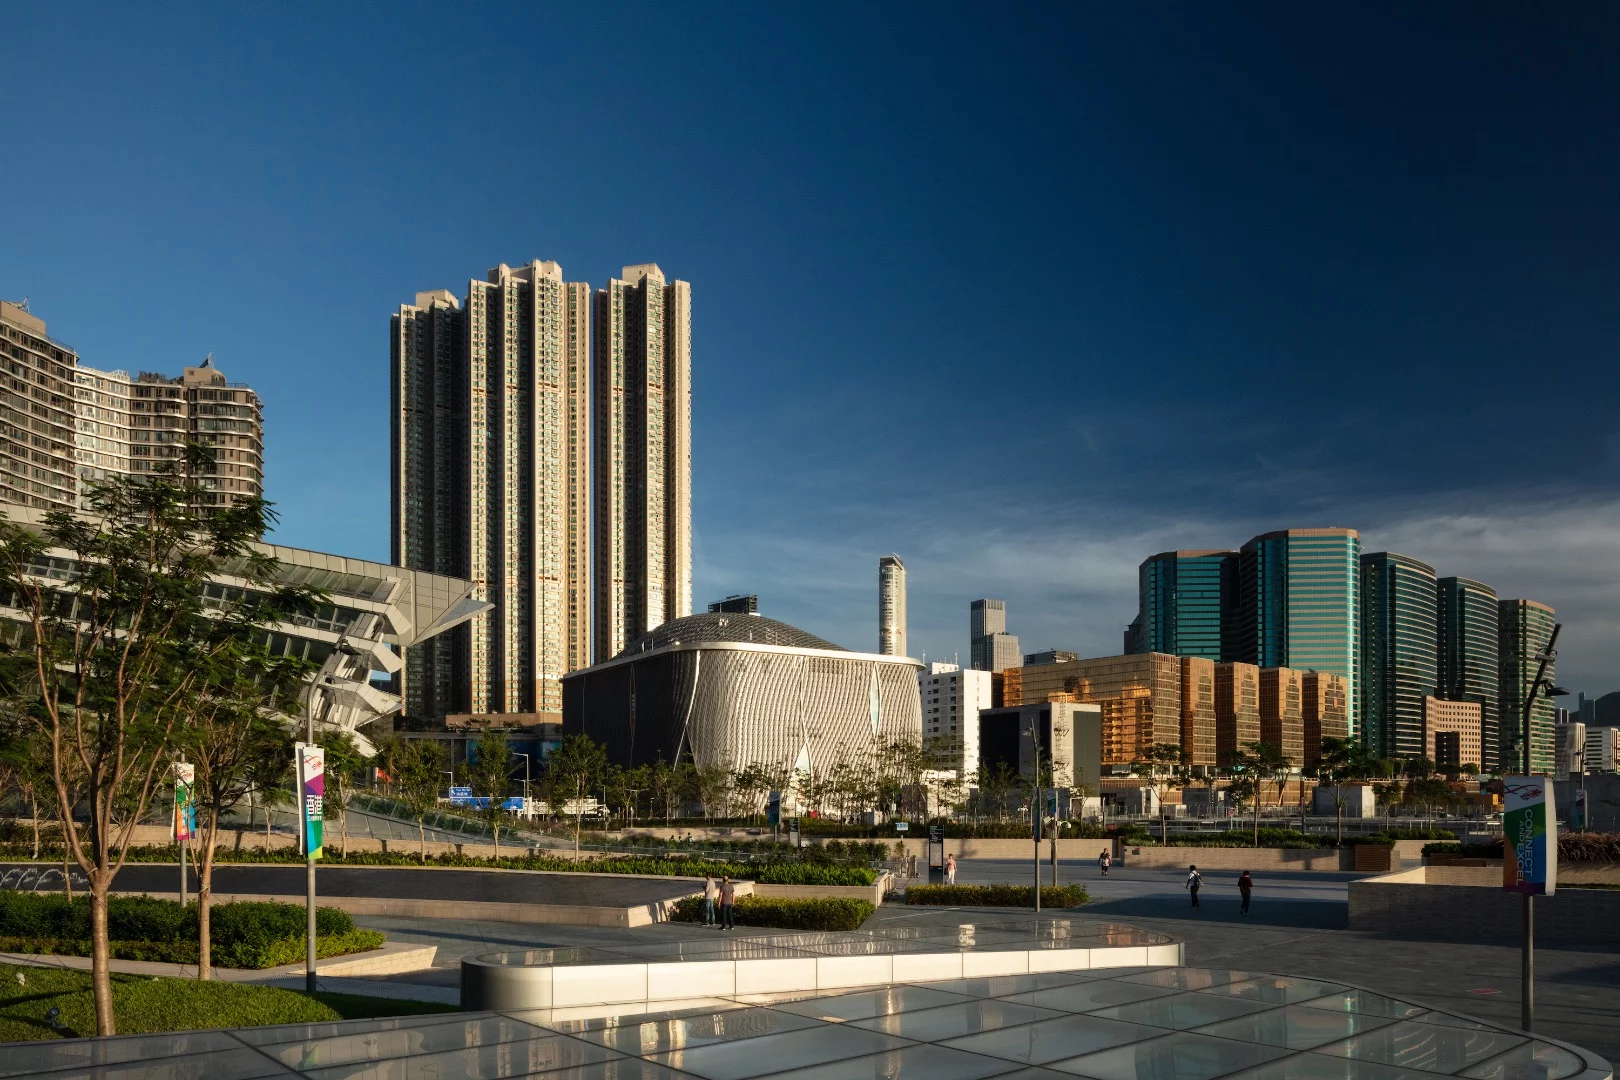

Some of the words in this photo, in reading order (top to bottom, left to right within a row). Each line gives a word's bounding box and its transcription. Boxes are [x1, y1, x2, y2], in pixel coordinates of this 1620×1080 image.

[306, 794, 322, 815] 香港
[1516, 842, 1525, 887] EXCEL
[1524, 809, 1533, 877] CONNECT
